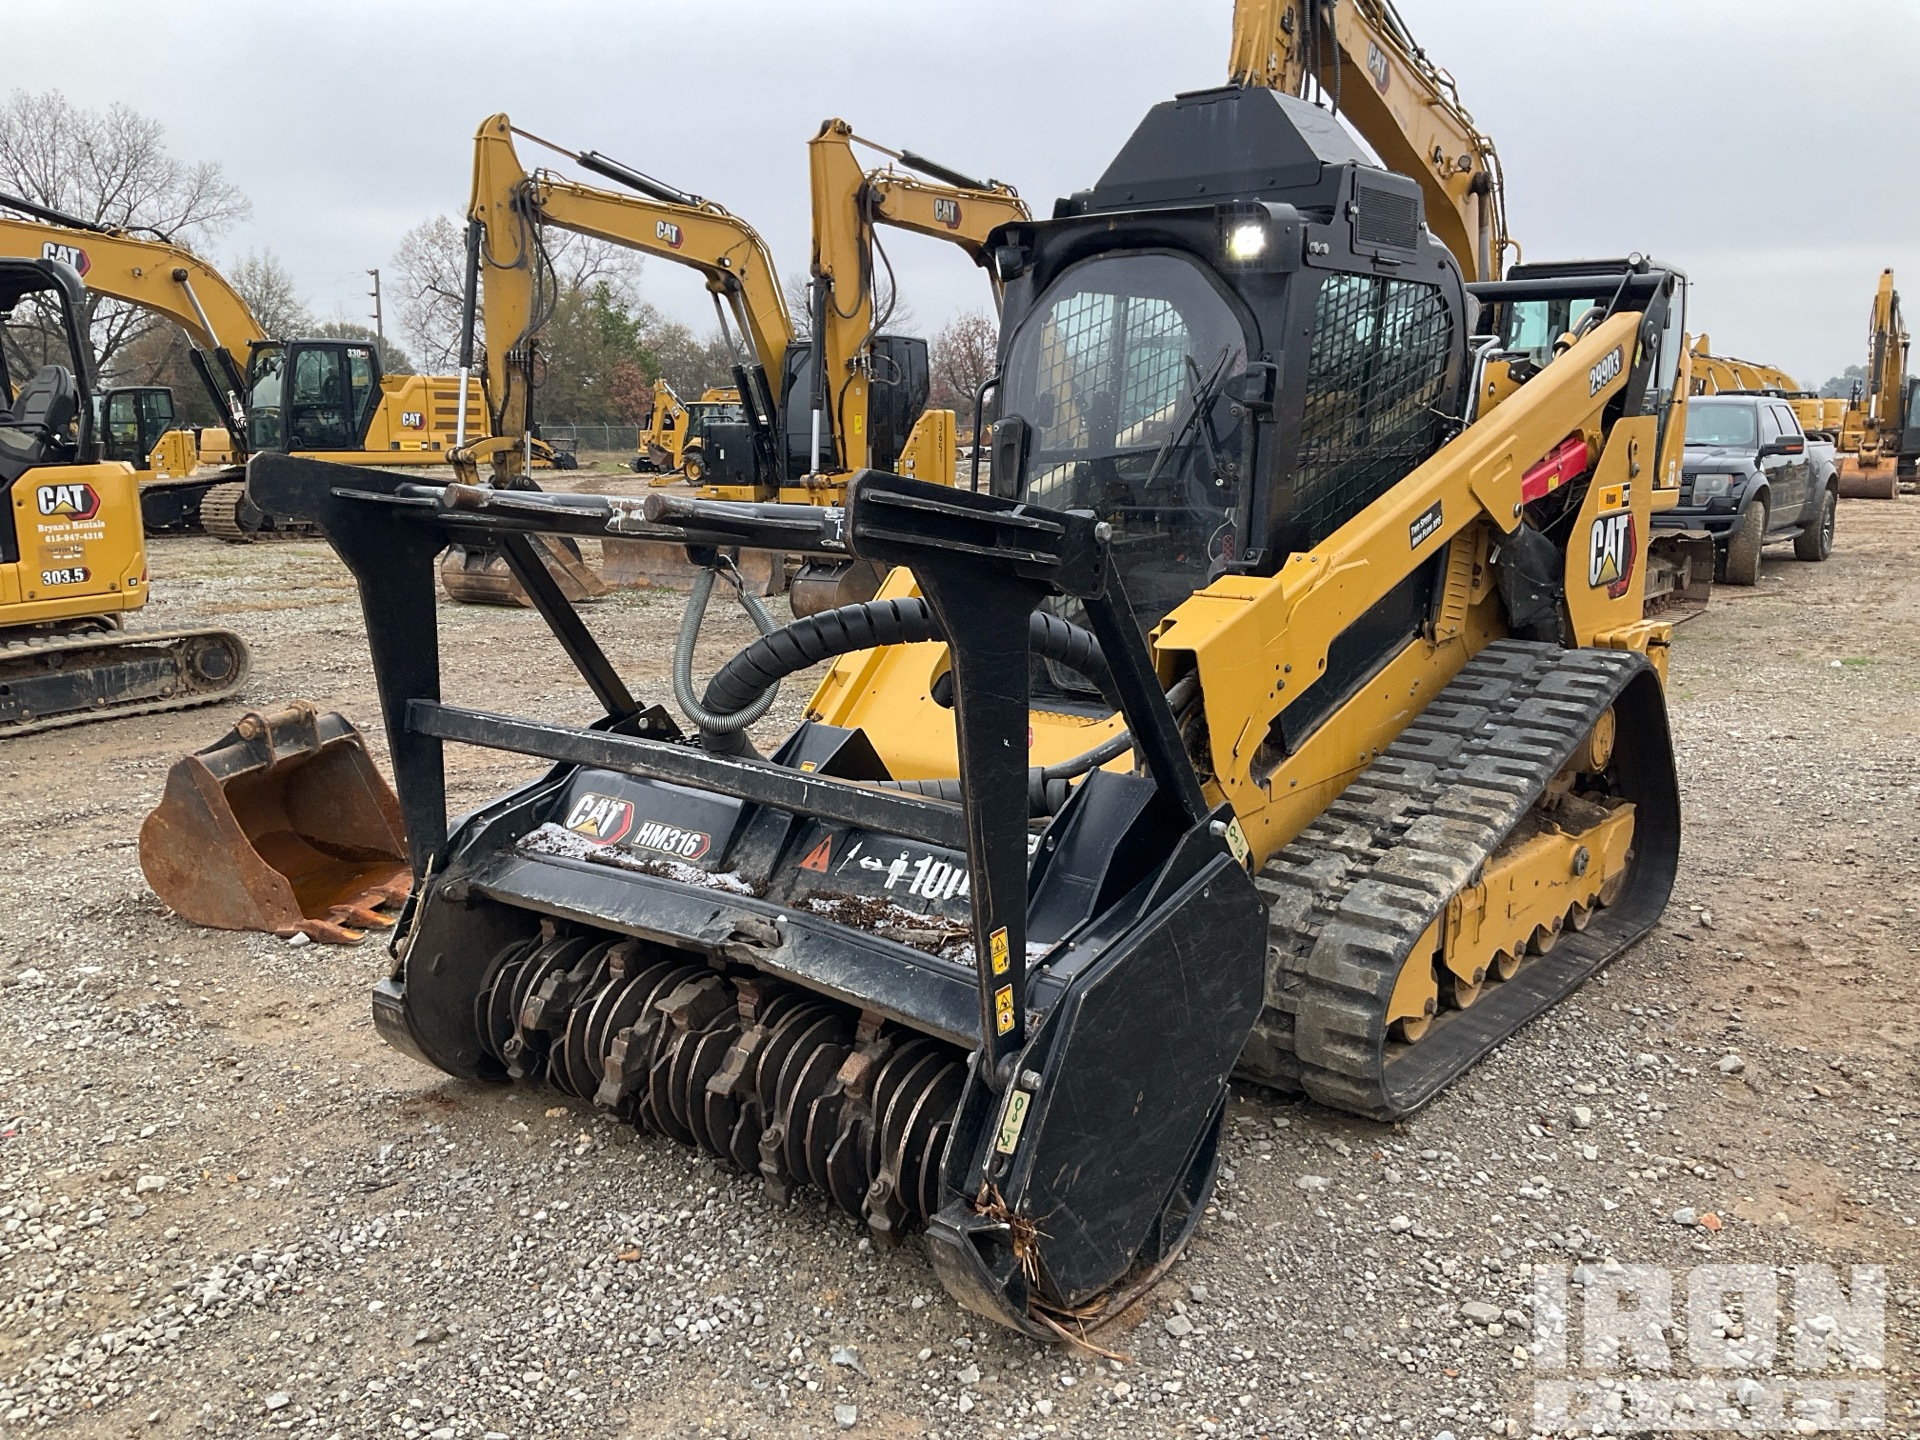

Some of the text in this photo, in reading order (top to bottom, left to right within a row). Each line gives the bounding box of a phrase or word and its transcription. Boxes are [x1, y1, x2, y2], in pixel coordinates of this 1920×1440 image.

[1368, 43, 1388, 83] CAT
[935, 198, 956, 223] CAT
[656, 220, 678, 244] CAT
[43, 242, 80, 270] CAT
[1590, 349, 1620, 397] 299D3
[402, 412, 421, 427] CAT
[37, 484, 84, 515] CAT
[37, 520, 105, 533] Bryan's Rentals
[1590, 514, 1629, 586] CAT
[42, 568, 84, 585] 303.5
[565, 793, 702, 857] CAT HM316
